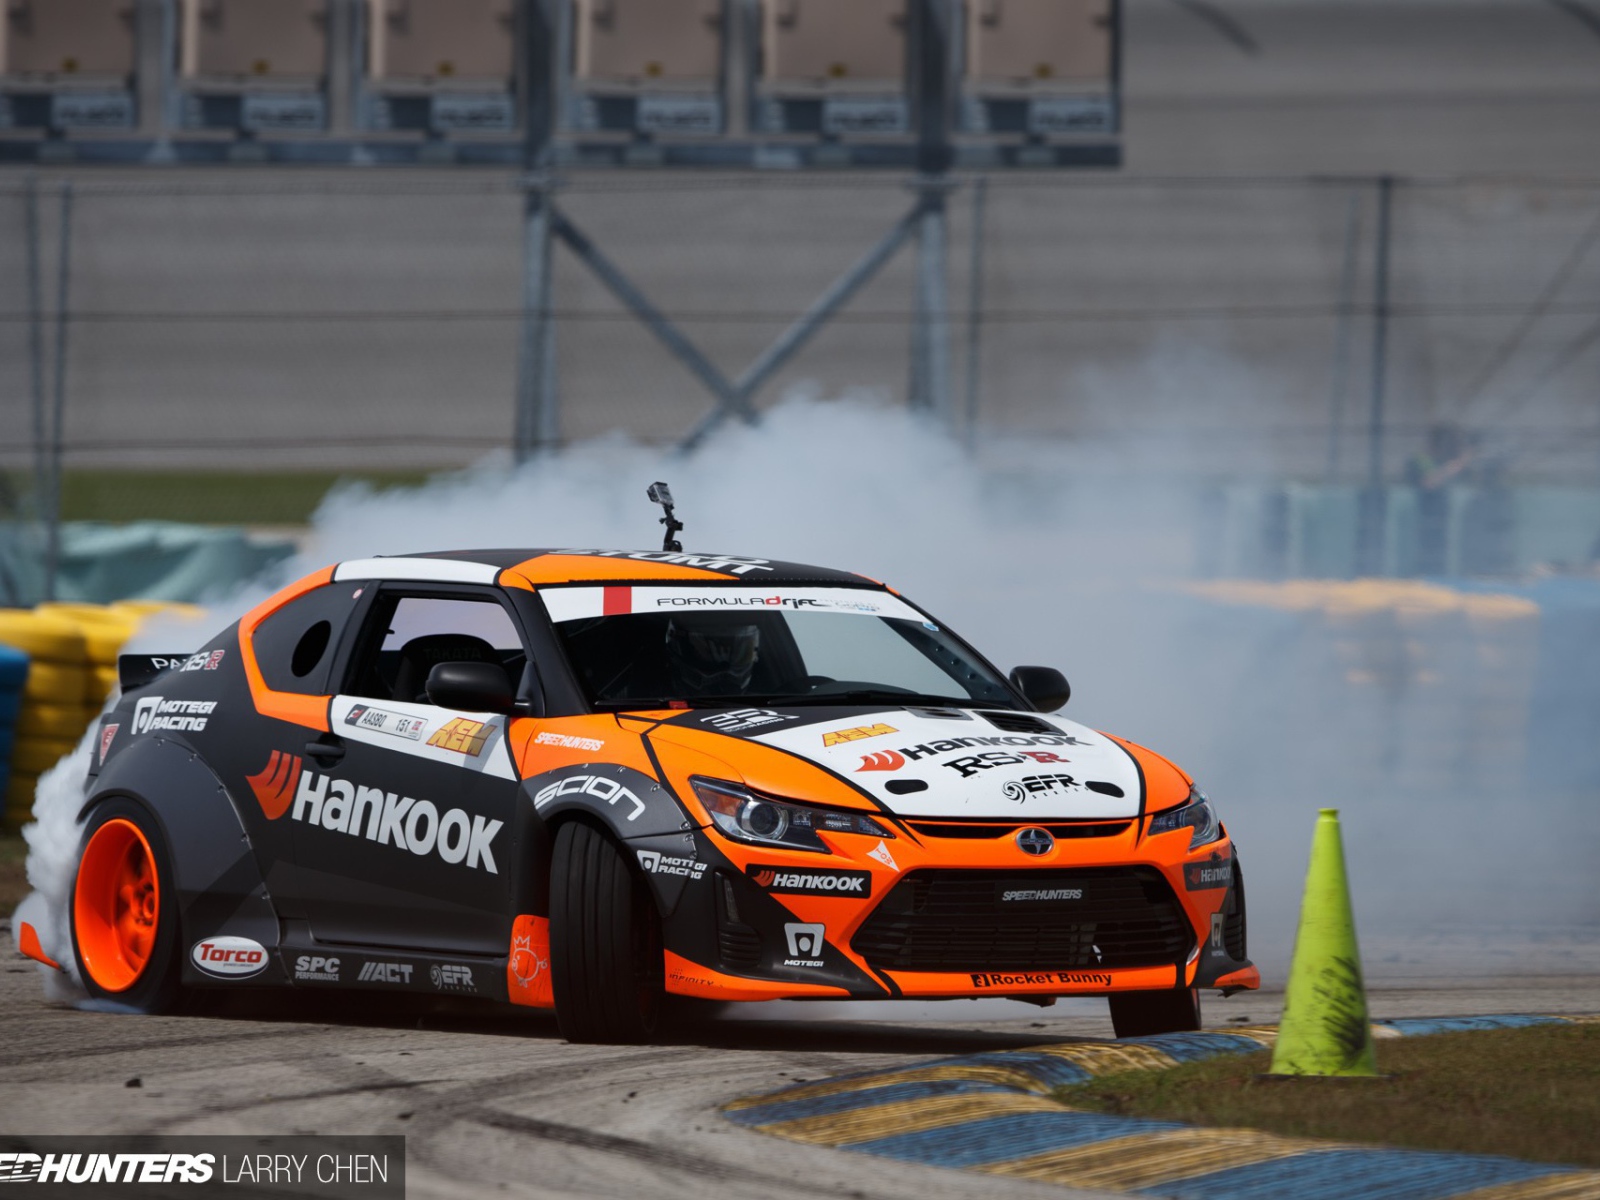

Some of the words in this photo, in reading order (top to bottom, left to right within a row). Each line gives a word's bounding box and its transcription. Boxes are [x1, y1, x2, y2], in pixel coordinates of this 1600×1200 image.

[157, 700, 217, 715] MOTEGI
[149, 716, 208, 731] RACING
[361, 711, 388, 728] AASBO
[395, 718, 412, 734] 151
[425, 716, 498, 758] AEM
[534, 731, 605, 752] SPEEDHUNTERS
[821, 722, 900, 748] AEM
[1021, 773, 1082, 793] EFR
[1002, 888, 1083, 901] SPEEDHUNTERS
[200, 943, 263, 964] Torco
[784, 959, 824, 967] MOTEGI
[295, 955, 341, 974] SPC
[295, 971, 340, 982] PERFORMANCE
[441, 964, 475, 986] EFR
[991, 974, 1054, 986] Rocket
[1057, 973, 1113, 986] Bunny
